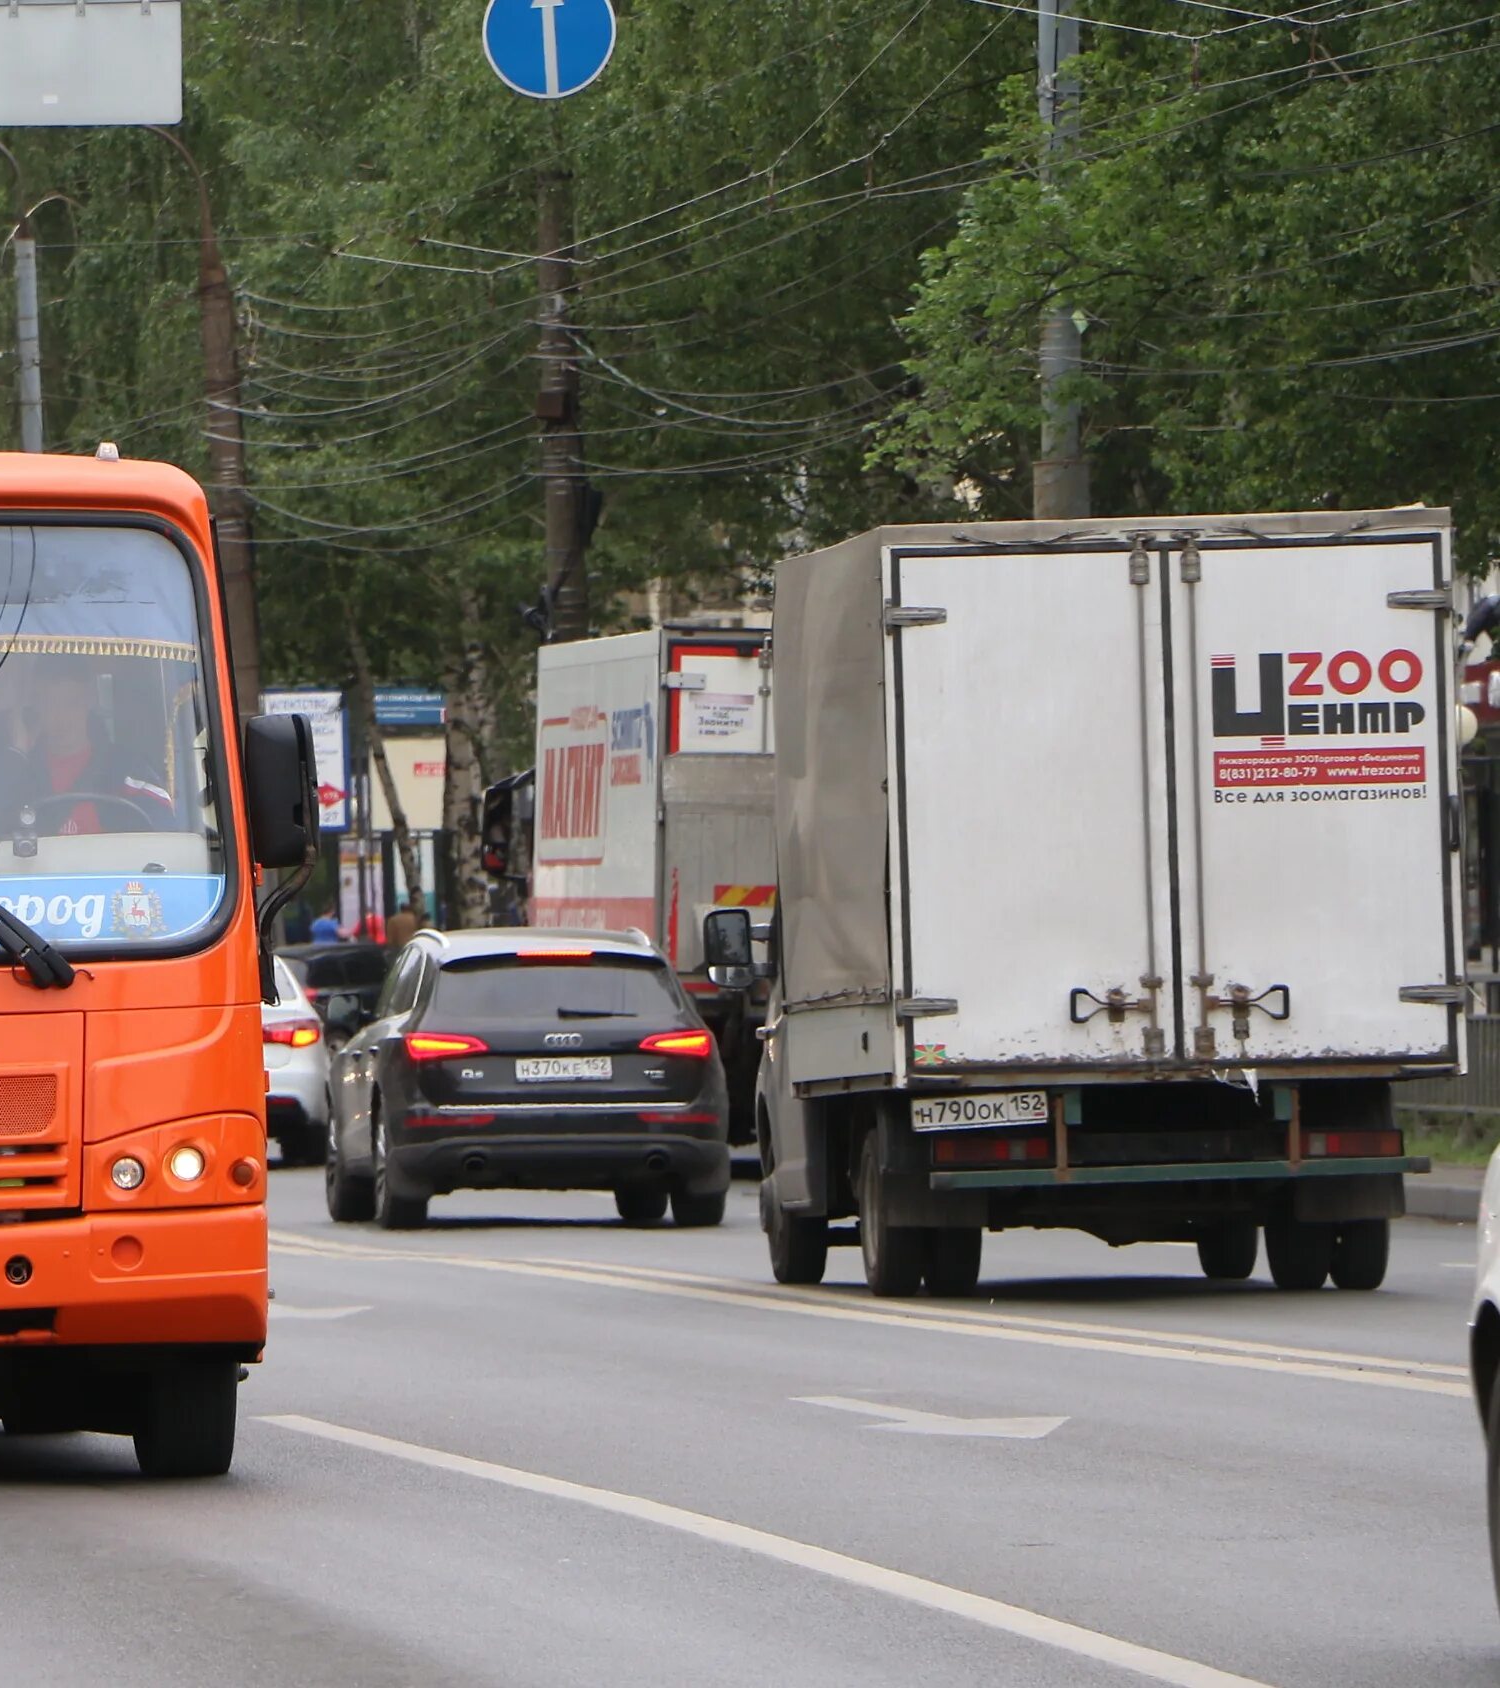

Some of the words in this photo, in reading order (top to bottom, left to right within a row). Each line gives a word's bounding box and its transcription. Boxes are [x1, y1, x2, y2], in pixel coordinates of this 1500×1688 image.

[1288, 648, 1423, 696] ZOO
[1219, 767, 1318, 781] 8(831)212-80-79
[1214, 789, 1248, 804] Все
[1253, 790, 1284, 804] для
[1290, 785, 1427, 803] зоомагазинов!
[920, 1100, 1005, 1123] Н790ОК
[1010, 1094, 1043, 1111] 152
